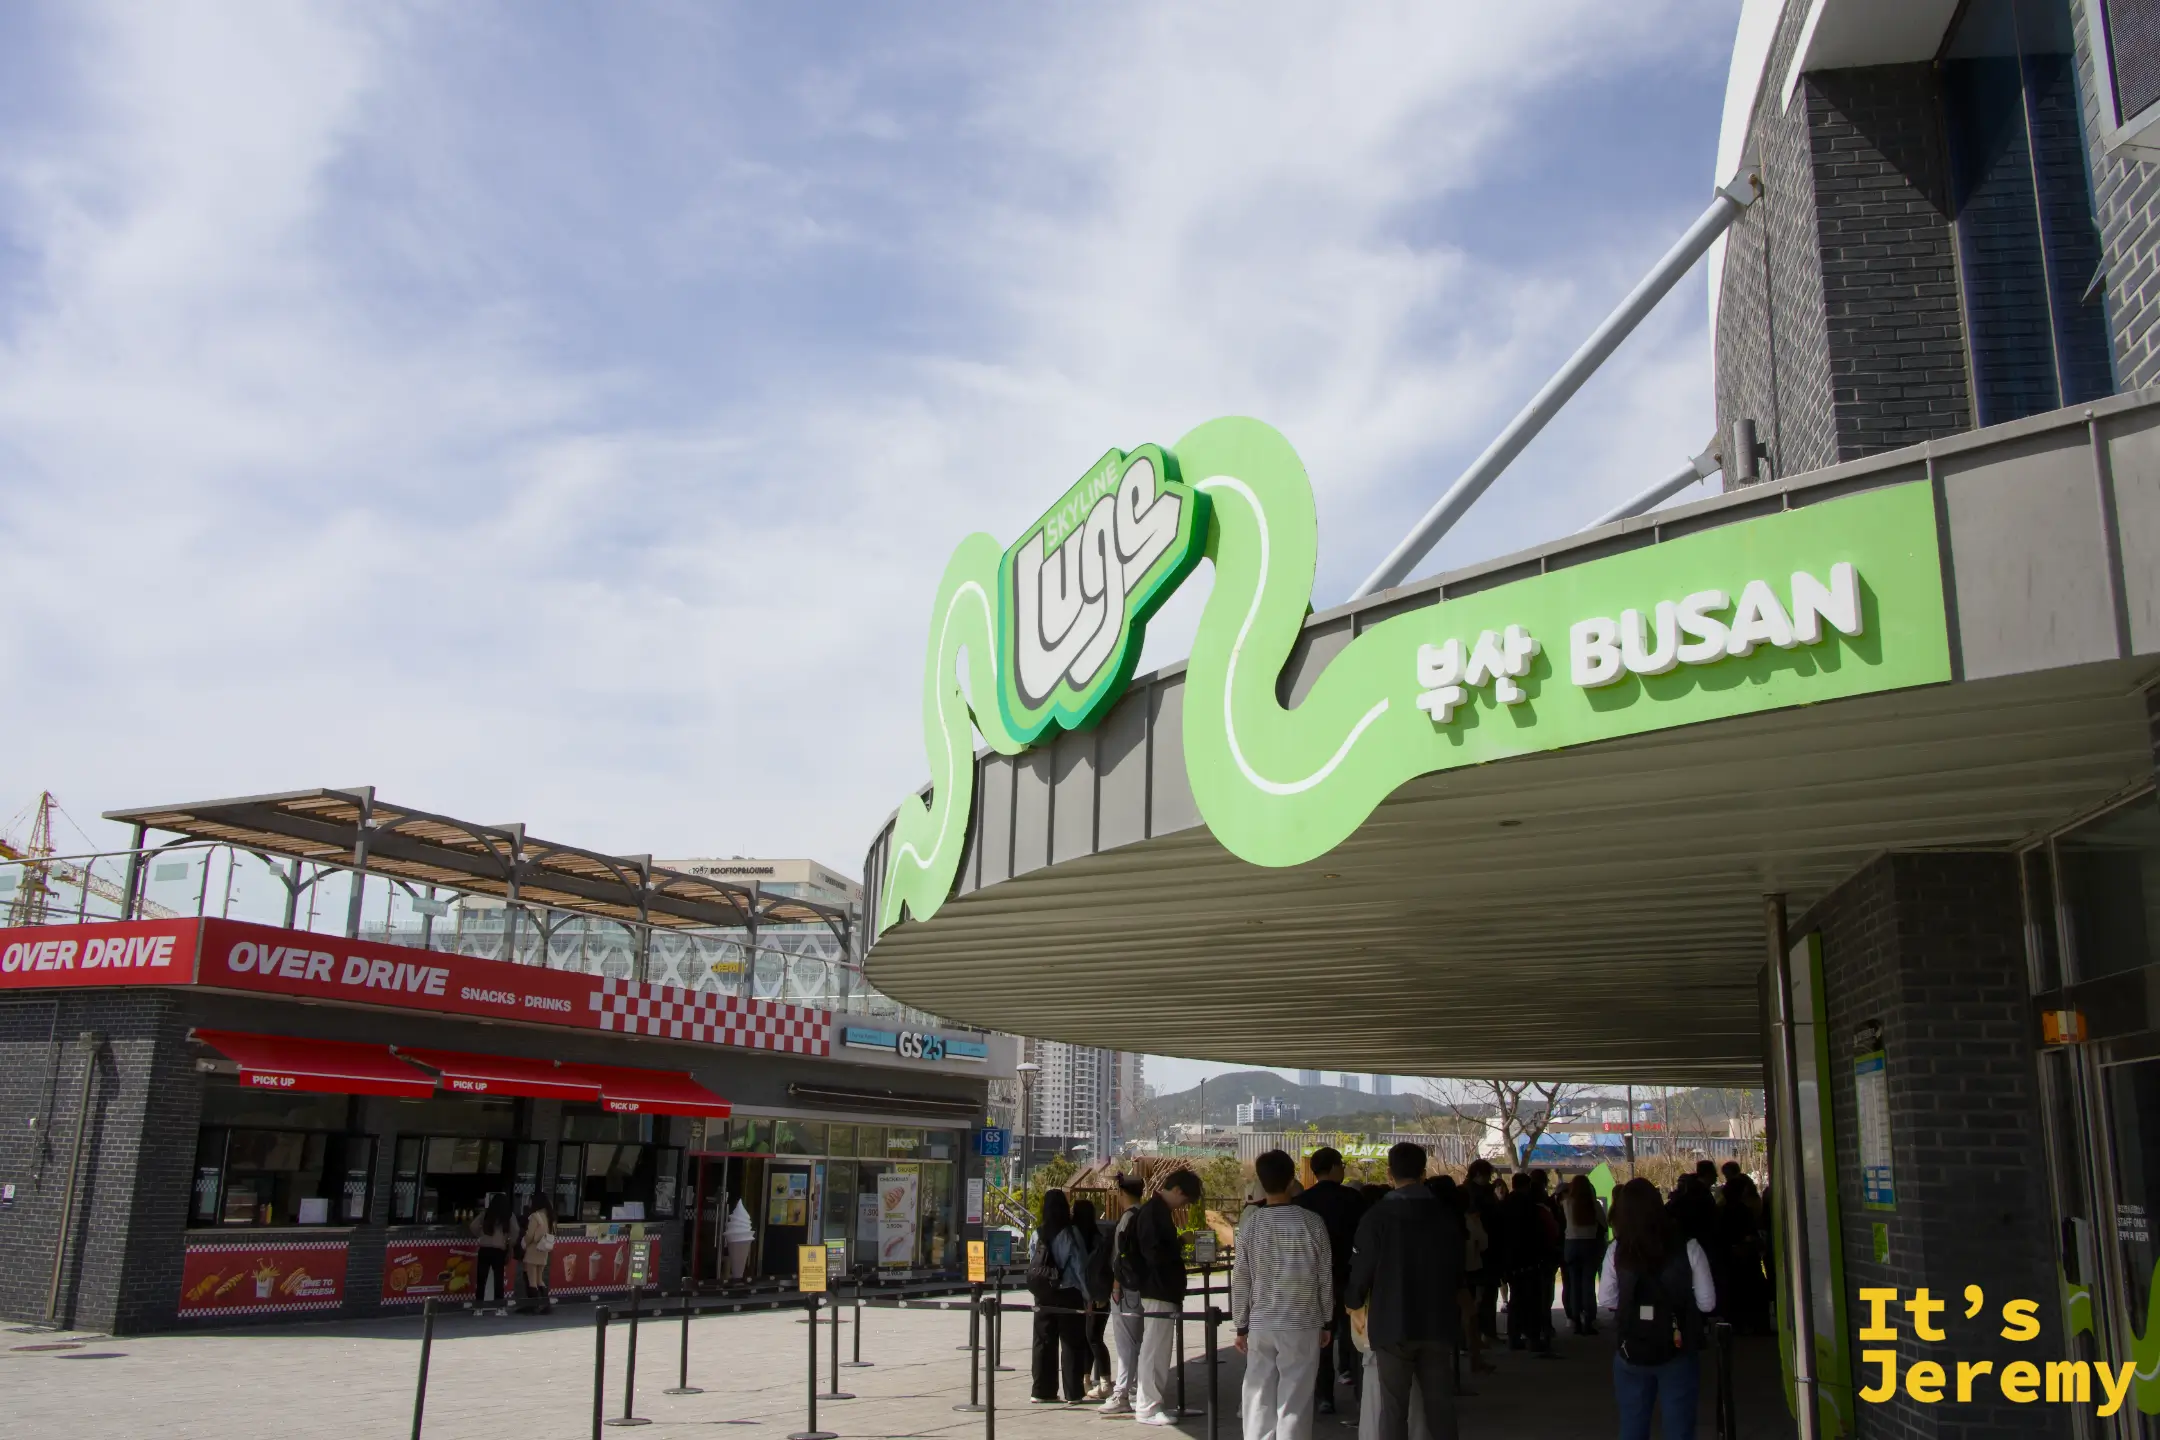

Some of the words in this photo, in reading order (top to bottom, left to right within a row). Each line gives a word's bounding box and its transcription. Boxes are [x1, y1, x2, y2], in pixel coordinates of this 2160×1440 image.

[1046, 461, 1118, 548] SKYLINE
[1013, 456, 1182, 710] Luge
[1416, 624, 1541, 723] 부산
[1570, 563, 1862, 688] BUSAN
[2, 939, 77, 972] OVER
[81, 936, 176, 968] DRIVE
[227, 942, 335, 982] OVER
[341, 956, 449, 996] DRIVE
[461, 986, 515, 1005] SNACKS
[525, 994, 572, 1012] DRINKS
[899, 1031, 943, 1060] GS25
[252, 1075, 276, 1086] PICK
[278, 1076, 295, 1087] UP
[453, 1080, 473, 1090] PICK
[475, 1081, 487, 1090] UP
[610, 1101, 627, 1110] PICK
[629, 1102, 639, 1111] UP
[985, 1131, 1000, 1143] GS
[985, 1143, 999, 1154] 25
[1345, 1144, 1376, 1156] PLAY
[2117, 1217, 2132, 1227] STAFF
[2133, 1218, 2146, 1228] ONLY
[302, 1279, 321, 1287] TIME
[295, 1288, 336, 1296] REFRESH
